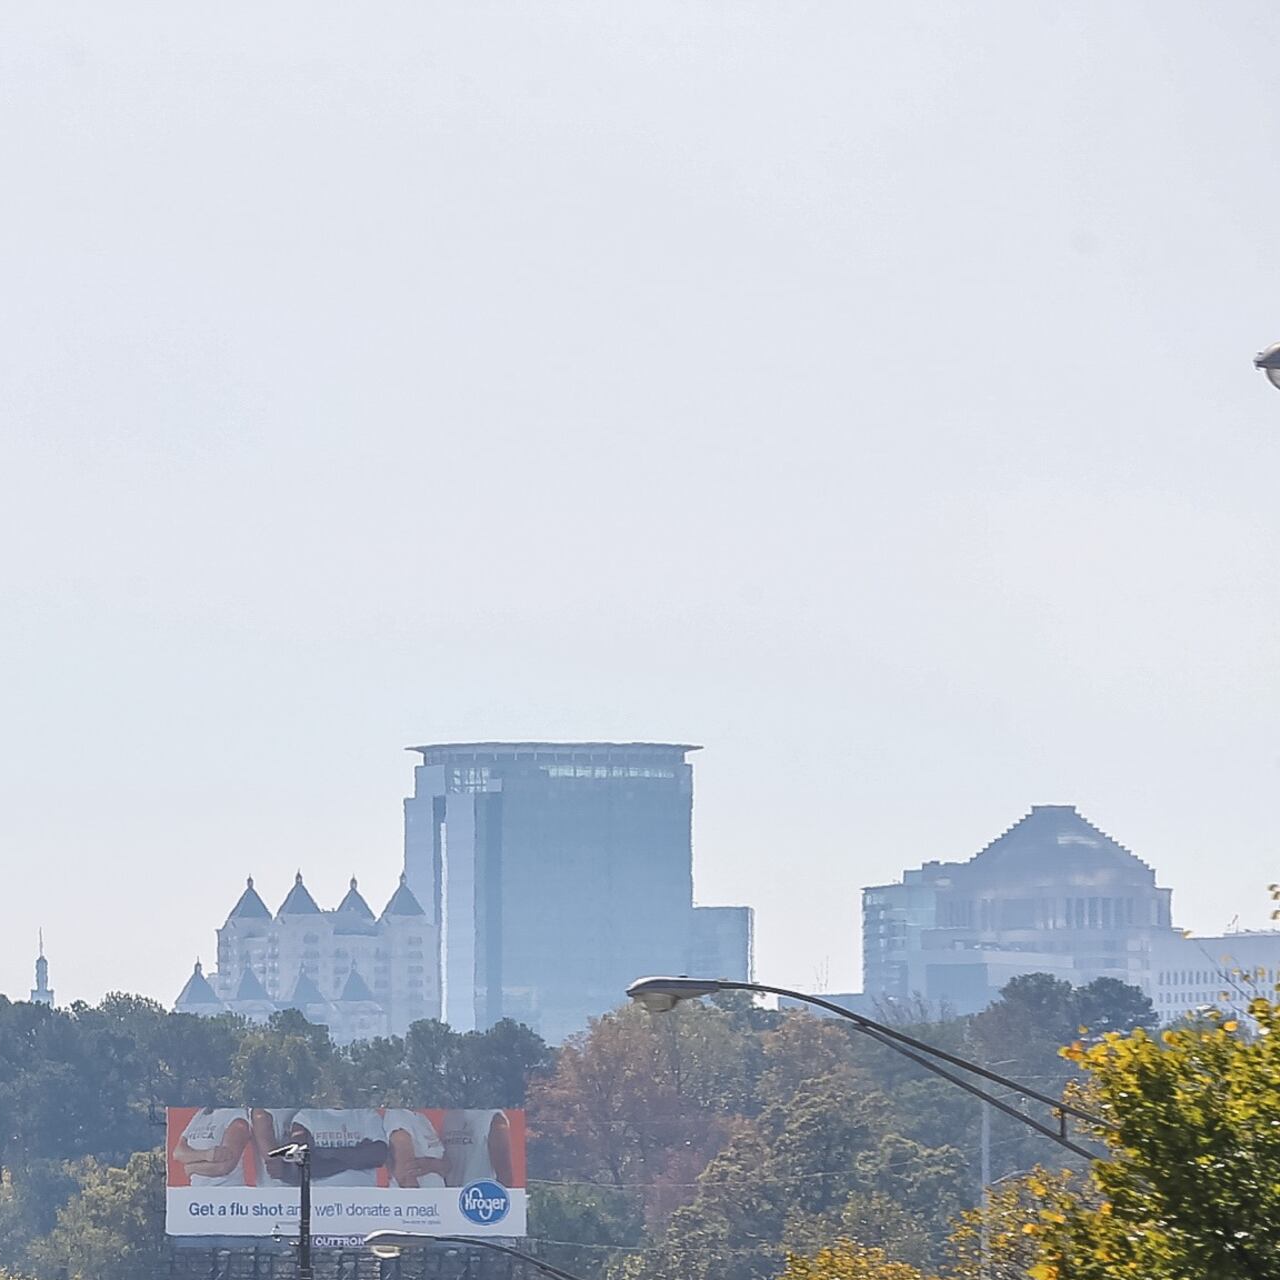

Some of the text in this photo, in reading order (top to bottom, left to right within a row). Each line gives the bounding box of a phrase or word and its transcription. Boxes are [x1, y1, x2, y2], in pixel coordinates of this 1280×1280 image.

[189, 1202, 440, 1217] Get a flu shot an we'll donate a meal.
[464, 1187, 506, 1220] Kroger
[315, 1237, 365, 1247] OUTFRON
